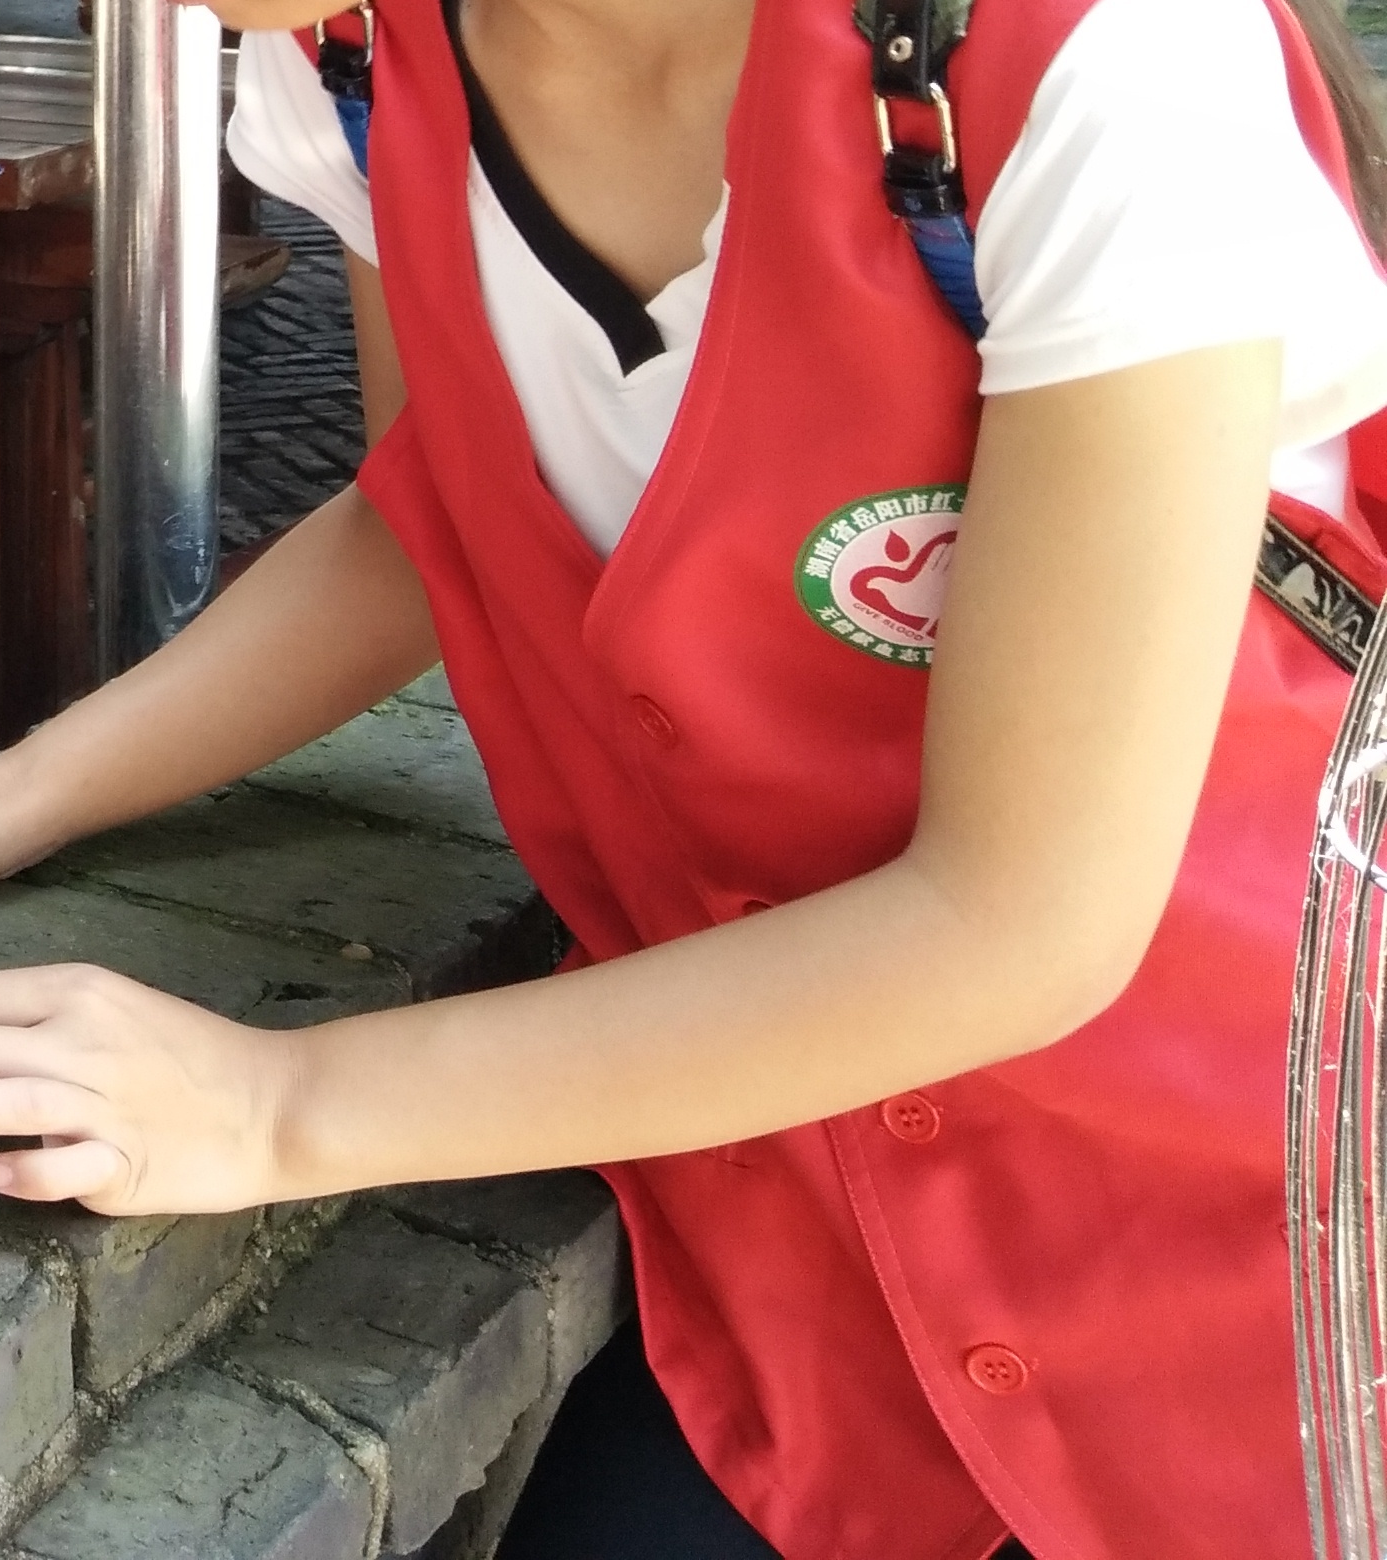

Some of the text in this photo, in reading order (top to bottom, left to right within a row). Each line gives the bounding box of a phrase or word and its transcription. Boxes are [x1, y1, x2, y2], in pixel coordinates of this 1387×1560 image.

[803, 491, 965, 579] 湖南省岳阳市红
[852, 602, 925, 642] GIVE BLOOD
